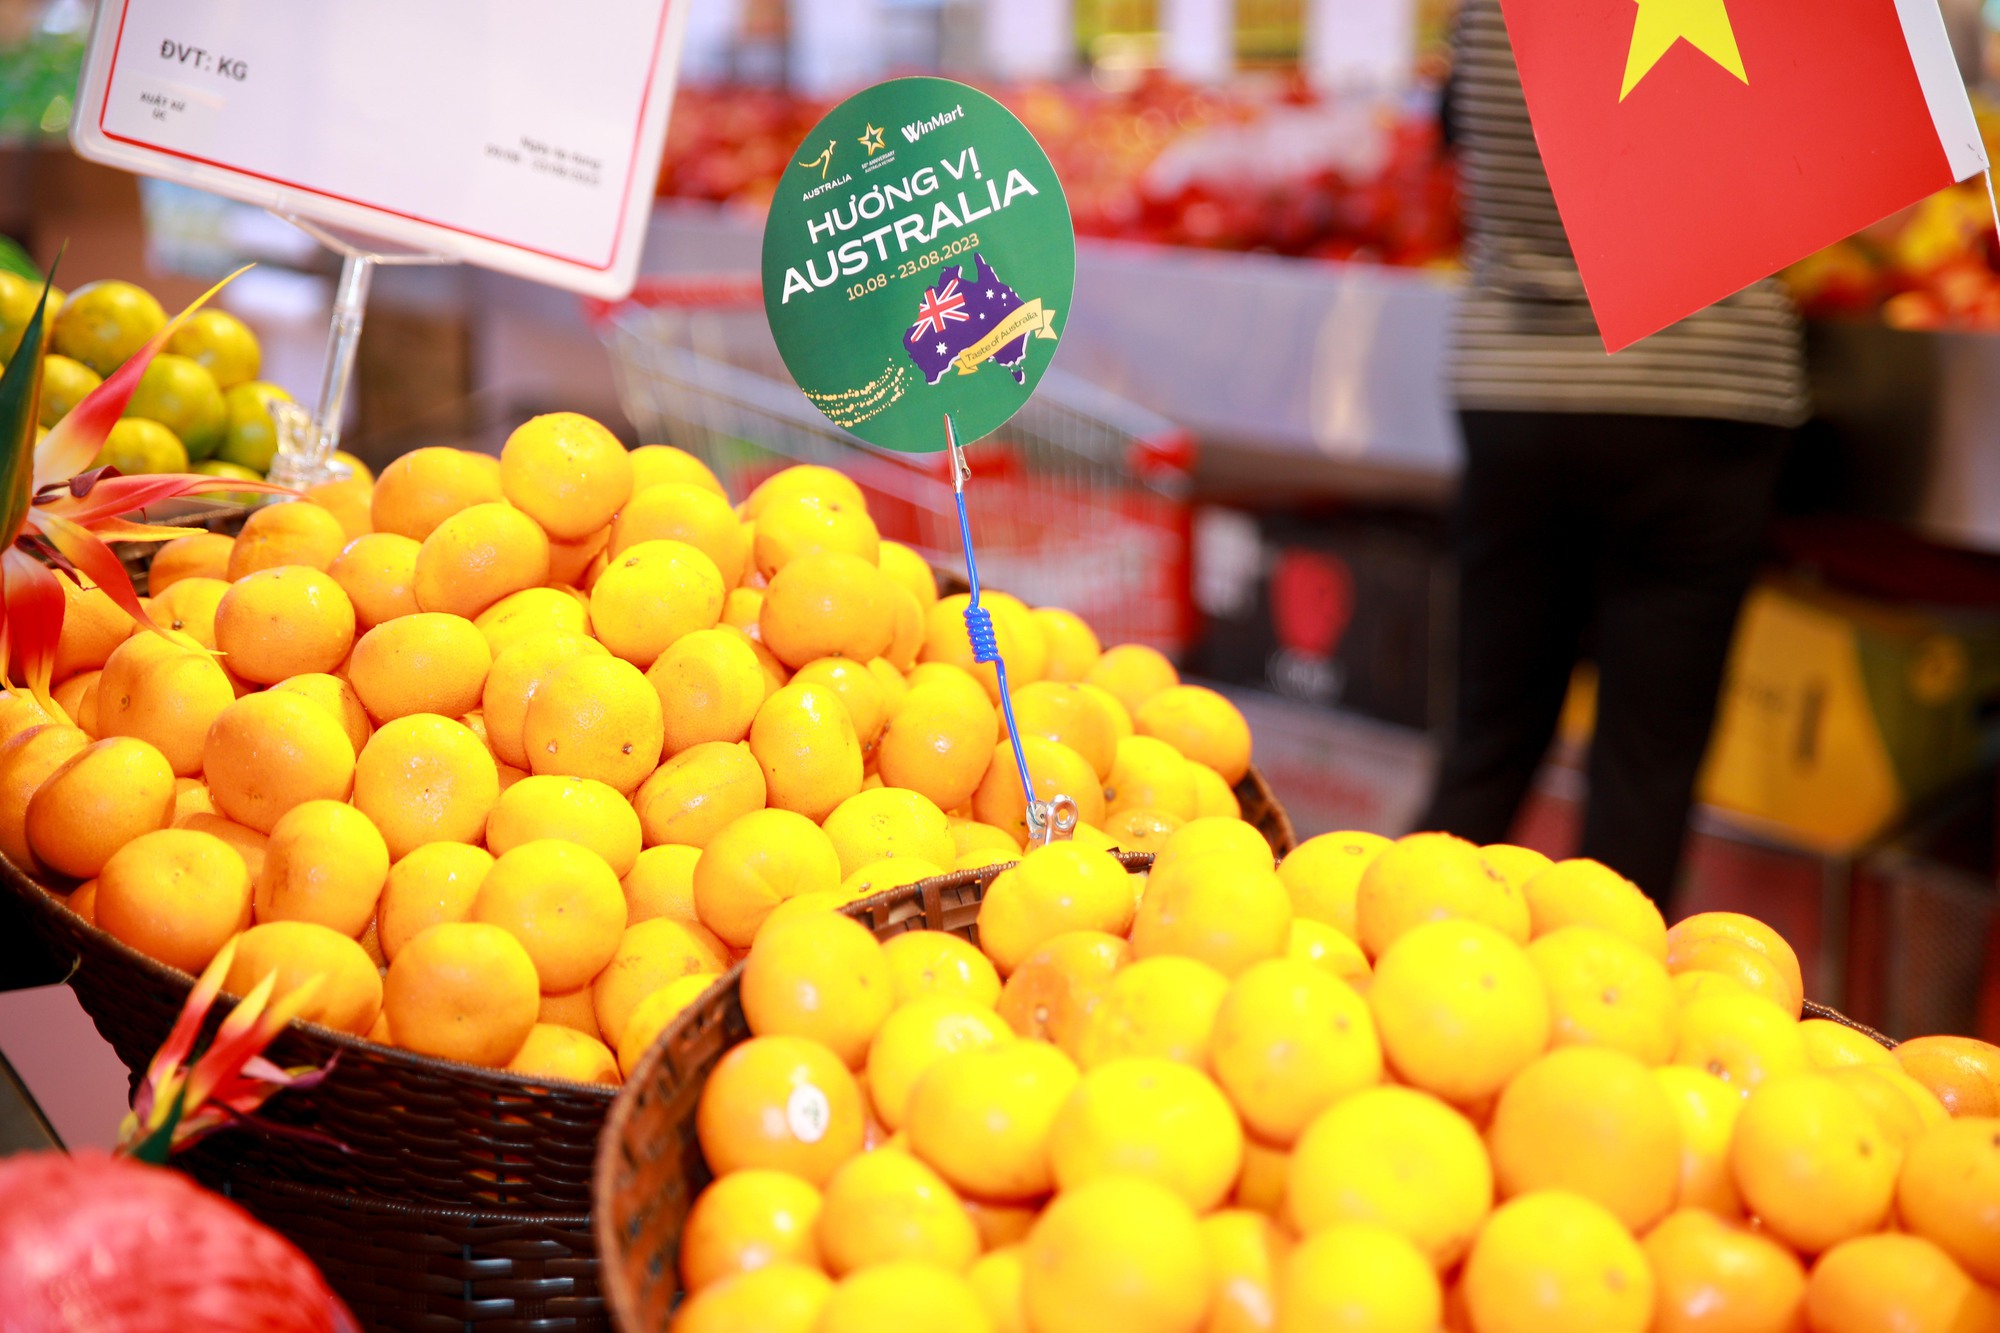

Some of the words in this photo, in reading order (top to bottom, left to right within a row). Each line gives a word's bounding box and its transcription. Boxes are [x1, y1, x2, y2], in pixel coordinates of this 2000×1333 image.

[159, 38, 212, 71] ĐVT:
[217, 55, 248, 82] KG
[901, 104, 965, 144] WinMart
[802, 173, 853, 202] AUSTRALIA
[806, 166, 939, 245] HƯƠNG
[940, 146, 982, 180] VỊ
[781, 168, 1039, 305] AUSTRALIA
[846, 273, 888, 302] 10.08
[897, 233, 980, 280] 23.08.2023
[965, 344, 992, 362] Taste
[991, 335, 1000, 348] of
[1000, 311, 1039, 340] Australia
